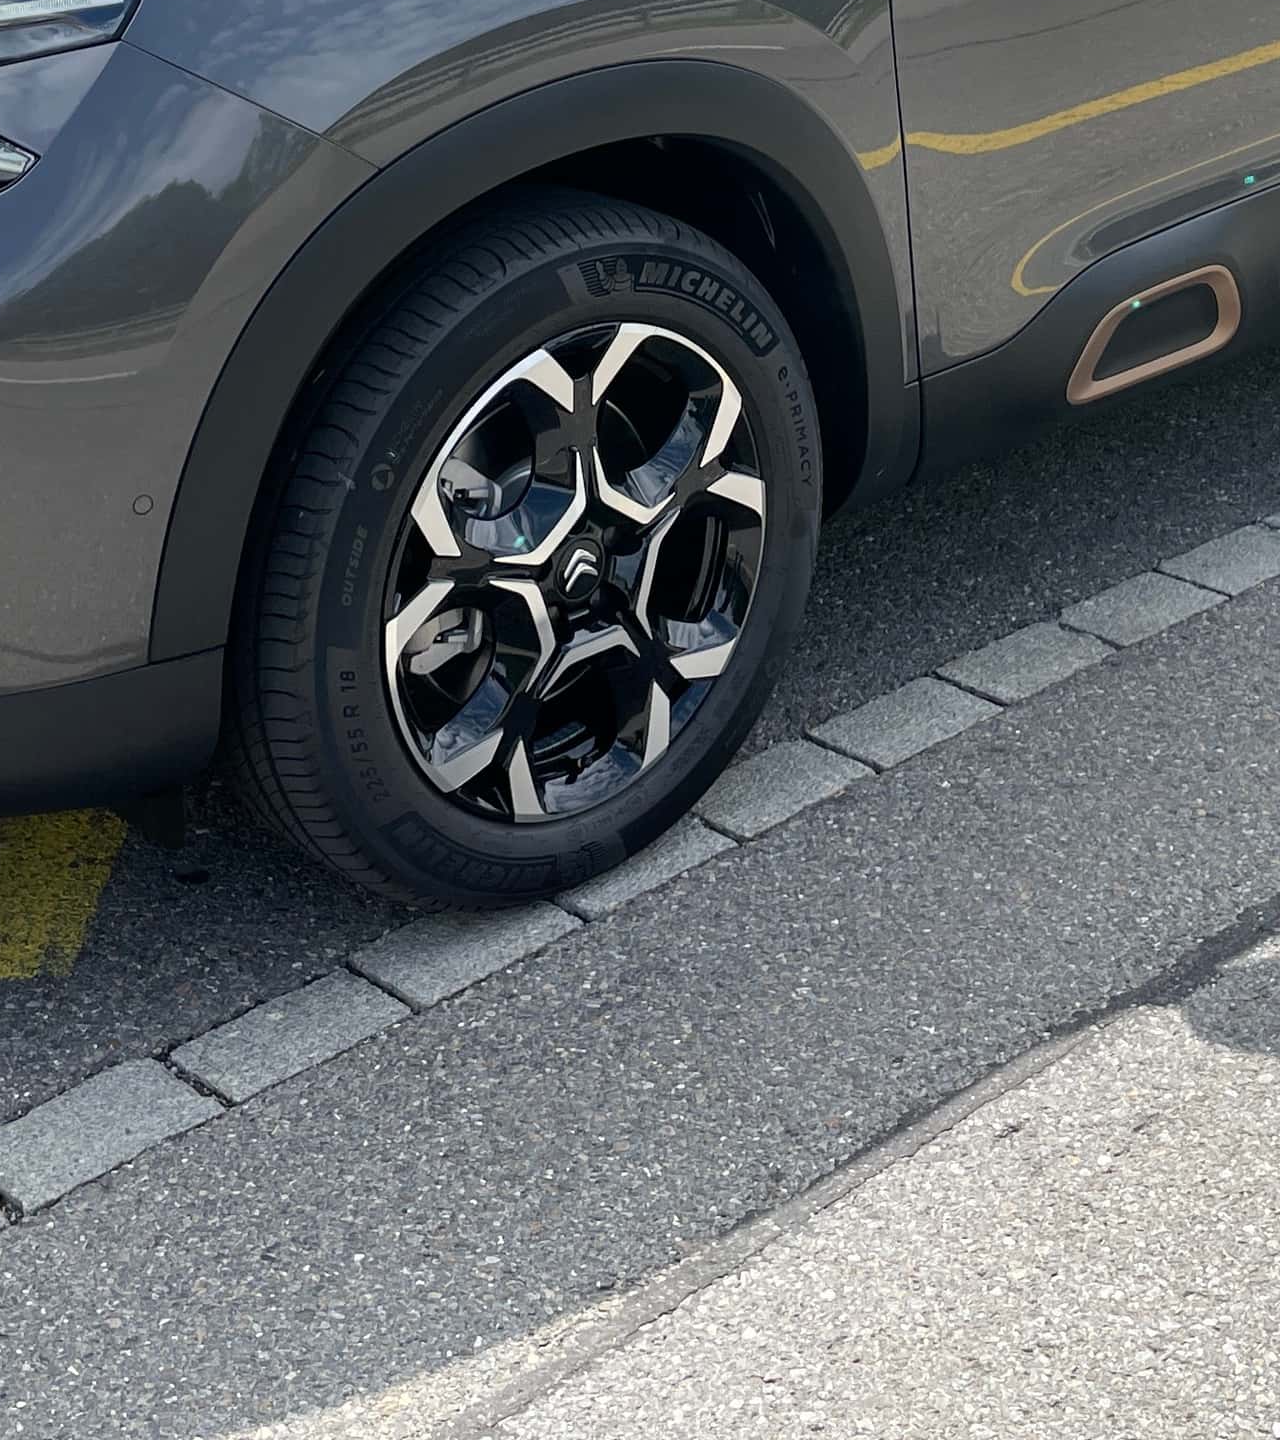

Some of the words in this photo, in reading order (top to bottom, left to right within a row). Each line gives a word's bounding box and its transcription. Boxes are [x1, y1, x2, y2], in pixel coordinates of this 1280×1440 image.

[636, 260, 774, 350] MICHELIN
[339, 523, 370, 607] OUTSIDE
[339, 669, 357, 692] 18
[342, 703, 361, 719] R
